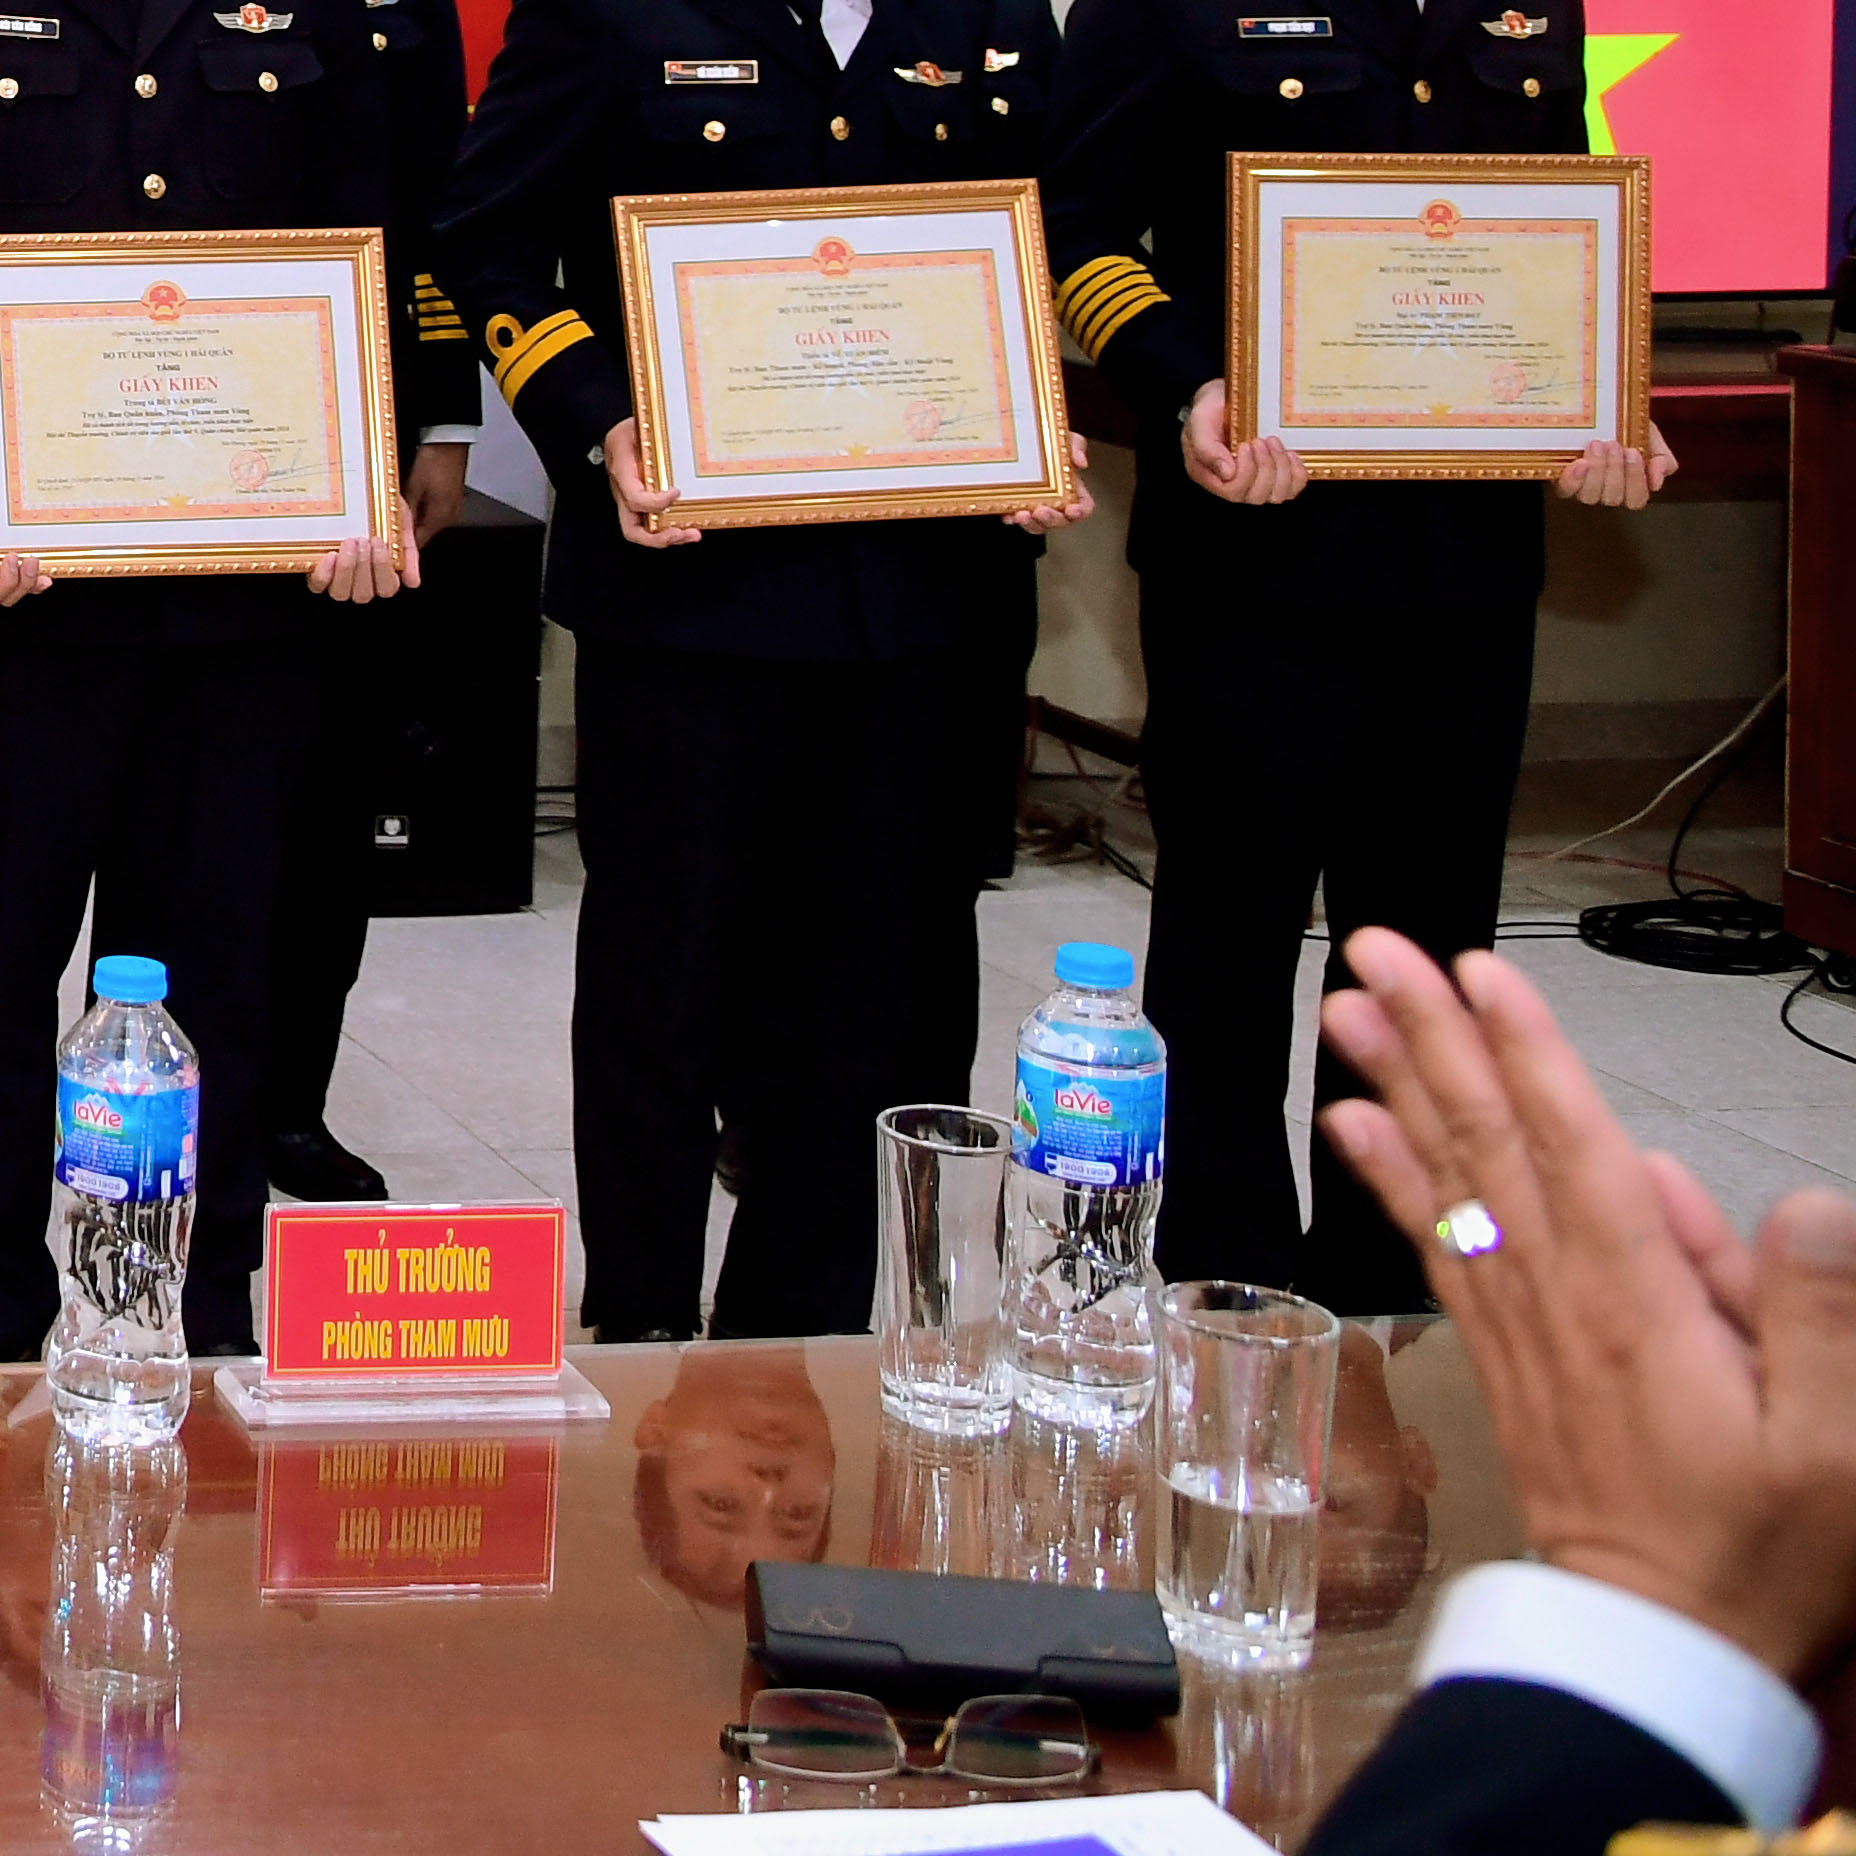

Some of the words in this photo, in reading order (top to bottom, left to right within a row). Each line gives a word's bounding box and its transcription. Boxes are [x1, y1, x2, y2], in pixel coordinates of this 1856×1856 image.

[1438, 292, 1486, 305] KHEN
[843, 329, 891, 344] KHEN
[119, 375, 163, 393] GIẤY
[169, 376, 219, 392] KHEN
[344, 1229, 390, 1295] THỦ
[396, 1228, 491, 1293] TRƯỞNG
[322, 1311, 393, 1361] PHÒNG
[398, 1318, 456, 1359] THAM
[462, 1314, 510, 1358] MƯU
